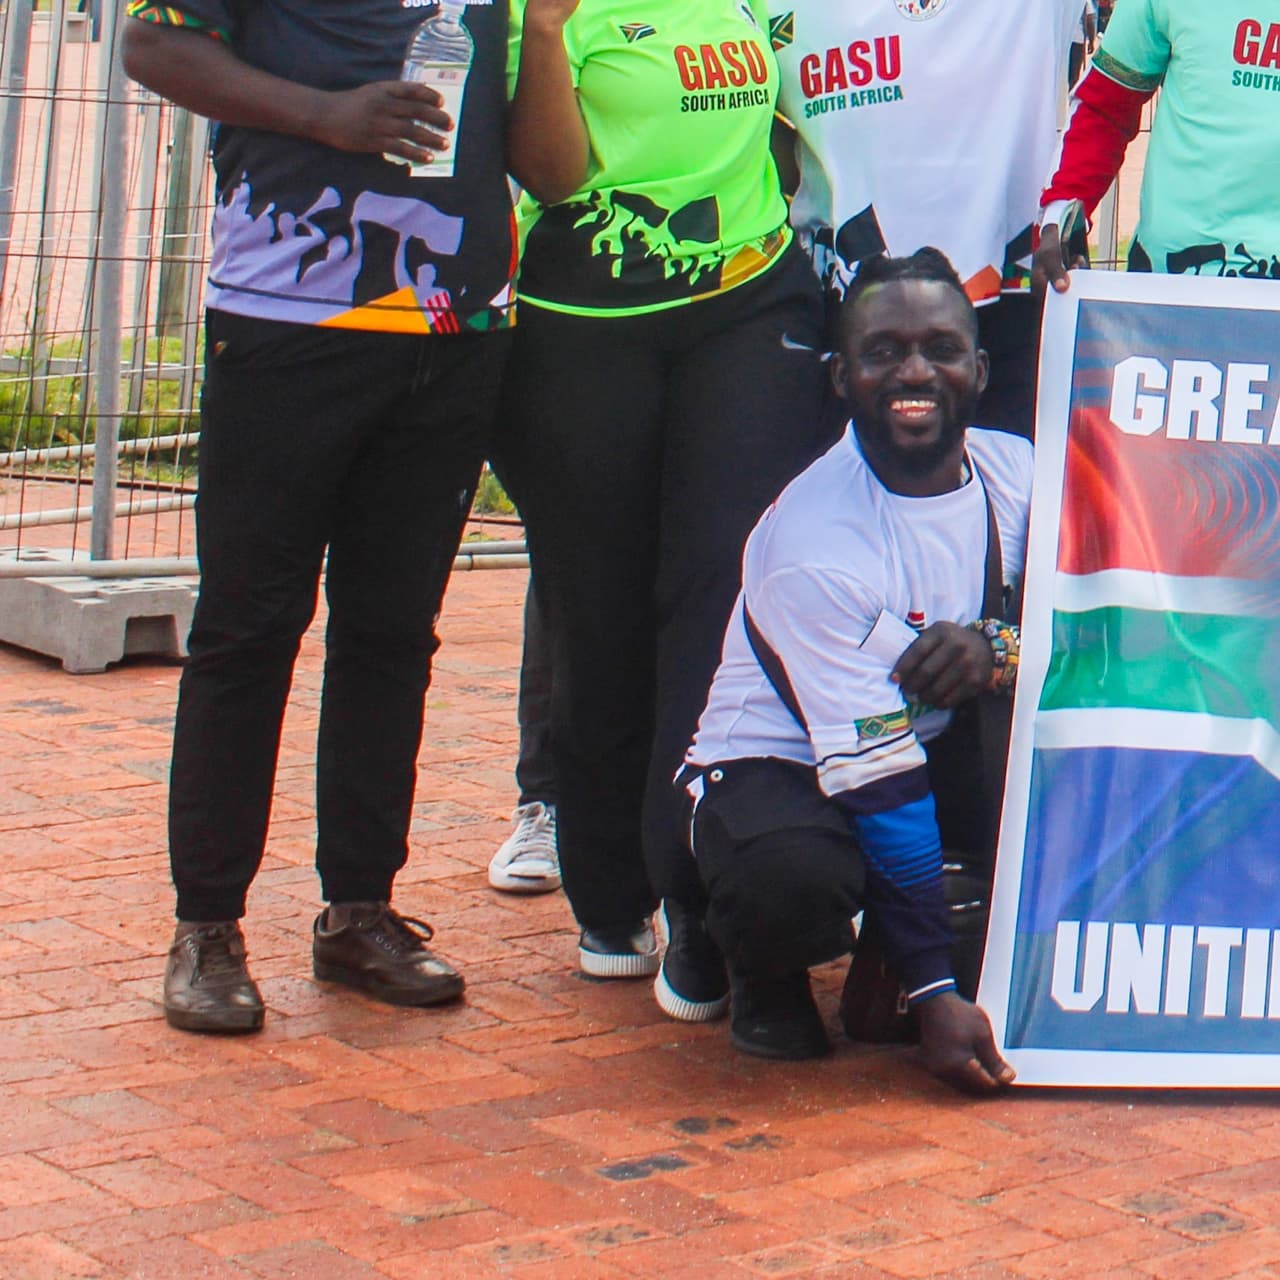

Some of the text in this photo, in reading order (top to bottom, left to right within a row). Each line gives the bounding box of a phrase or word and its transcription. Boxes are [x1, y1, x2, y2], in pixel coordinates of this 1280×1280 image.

[675, 40, 768, 91] GASU
[800, 35, 901, 99] GASU
[681, 93, 725, 112] SOUTH
[804, 85, 903, 119] SOUTH AFRICA
